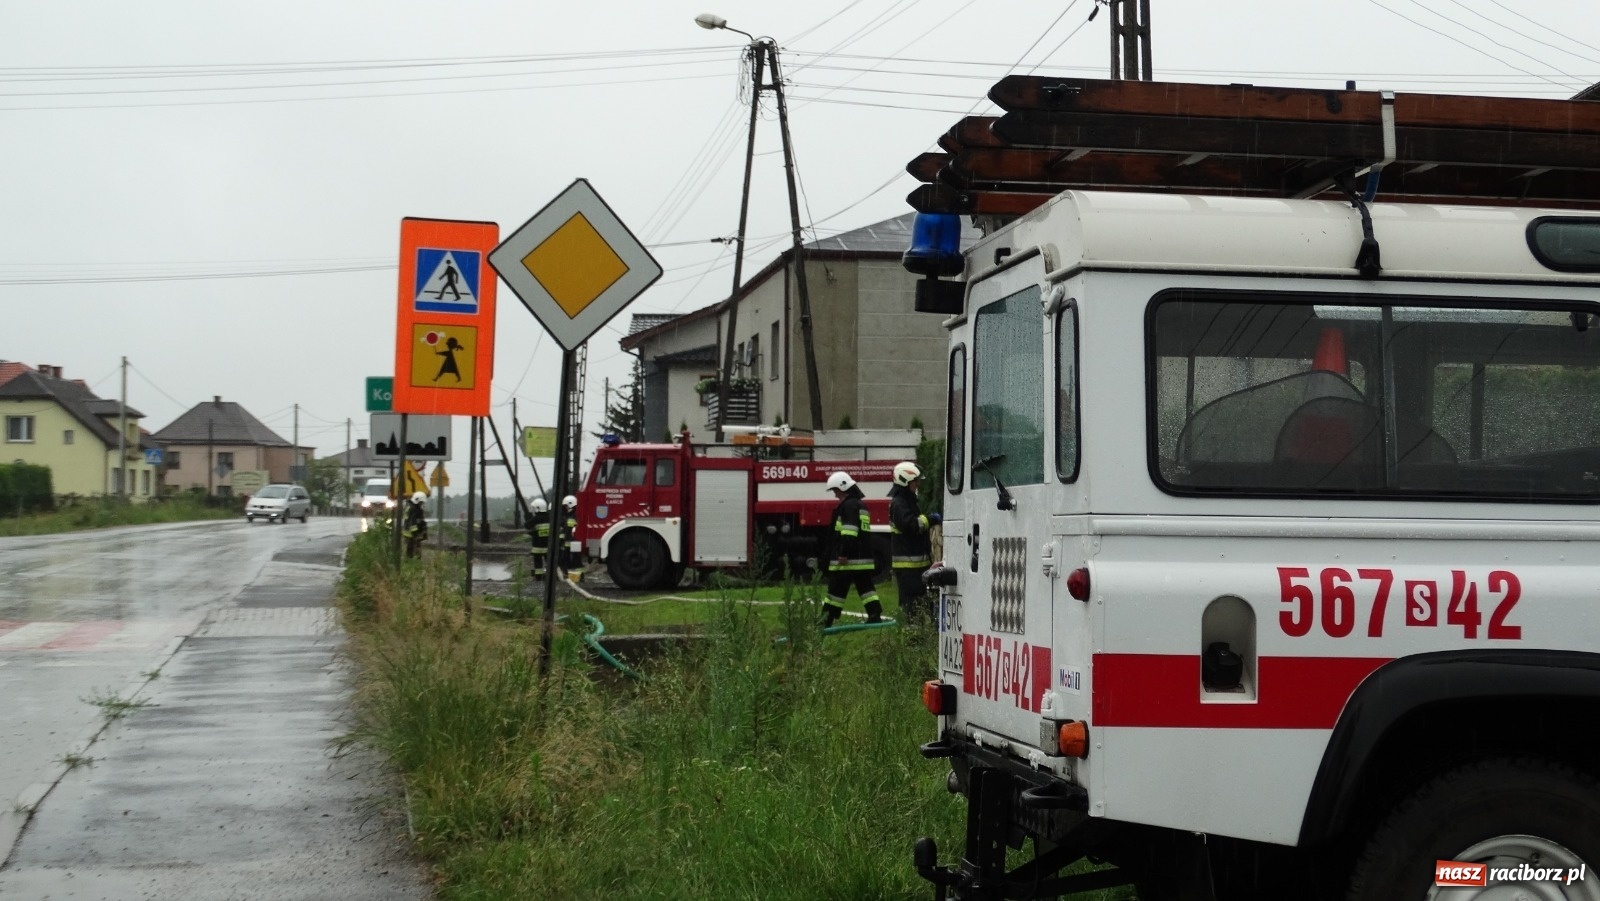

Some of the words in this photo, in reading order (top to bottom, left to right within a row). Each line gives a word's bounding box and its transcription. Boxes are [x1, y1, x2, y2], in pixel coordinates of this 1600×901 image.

[373, 389, 392, 401] Ko
[762, 466, 785, 479] 569
[793, 465, 808, 479] 40
[947, 598, 962, 632] SRC
[1277, 567, 1394, 638] 567
[1447, 570, 1522, 640] 42
[976, 634, 1001, 702] 567
[1012, 641, 1030, 711] 42
